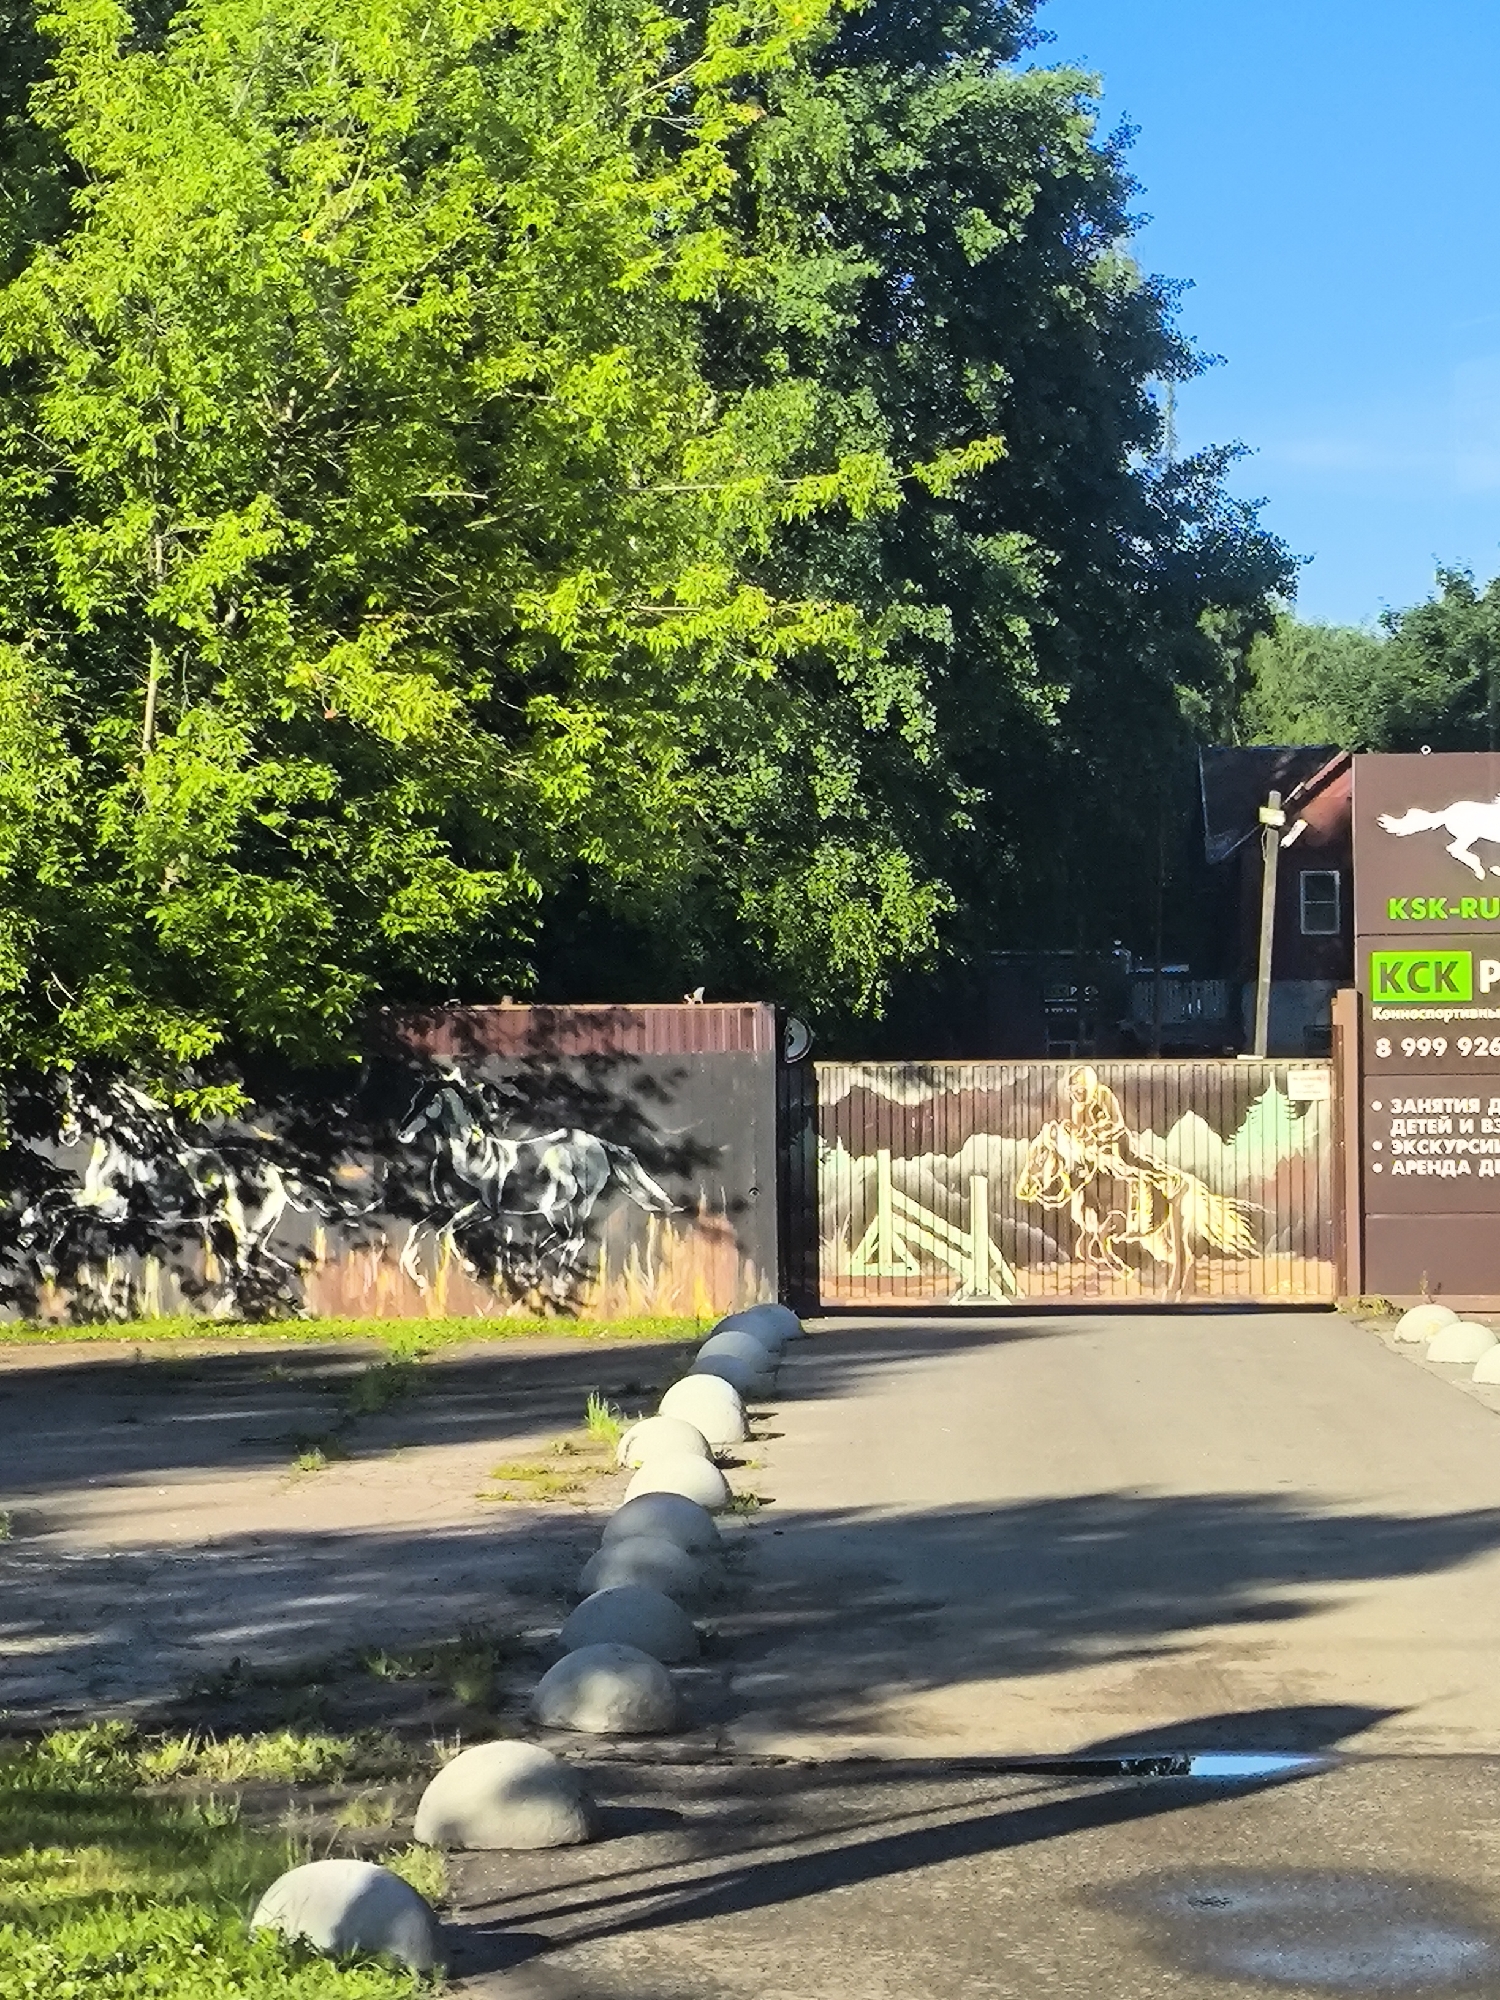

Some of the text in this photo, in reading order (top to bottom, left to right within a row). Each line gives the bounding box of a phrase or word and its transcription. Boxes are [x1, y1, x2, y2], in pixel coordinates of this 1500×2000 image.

[1388, 897, 1500, 920] KSK-RU
[1380, 961, 1460, 993] КСК
[1375, 1036, 1500, 1058] 8 999 926
[1390, 1098, 1480, 1114] ЗАНЯТИЯ
[1390, 1115, 1453, 1137] ДЕТЕЙ
[1459, 1118, 1474, 1134] И
[1391, 1159, 1471, 1178] АРЕНДА
